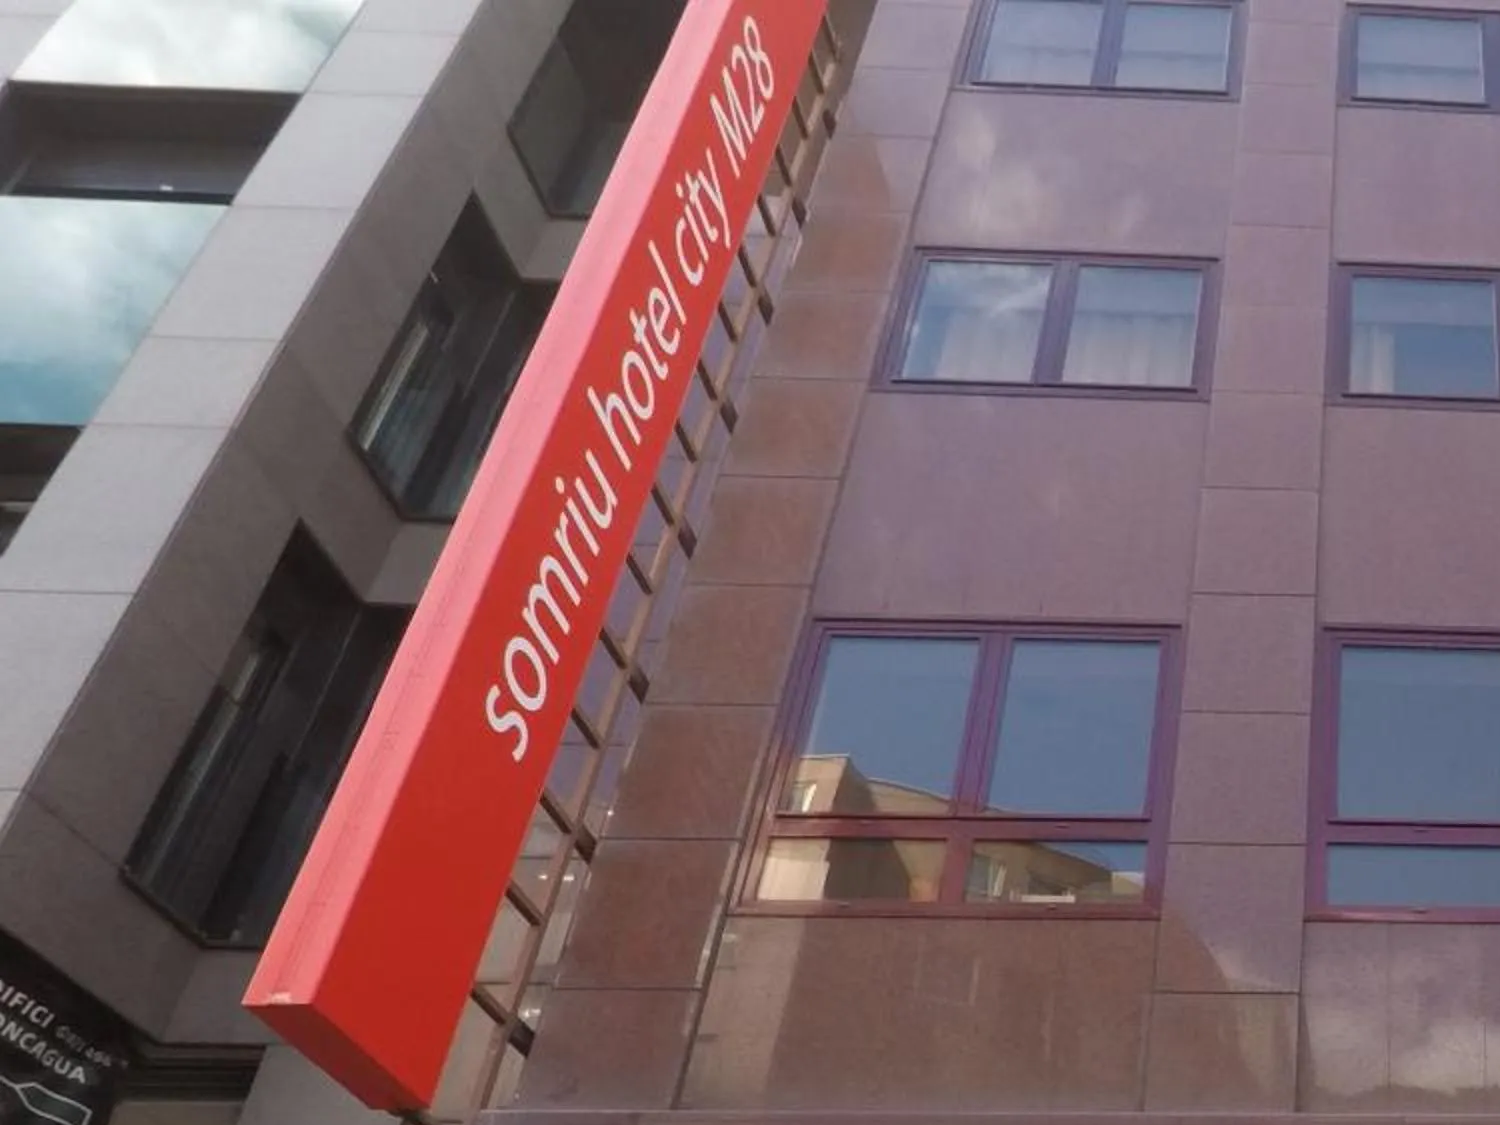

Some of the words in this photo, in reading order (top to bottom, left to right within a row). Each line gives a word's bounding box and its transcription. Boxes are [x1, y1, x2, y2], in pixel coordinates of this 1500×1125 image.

[485, 450, 618, 760] somriu
[587, 241, 688, 470] hotel
[675, 146, 731, 287] city
[709, 15, 776, 178] M28
